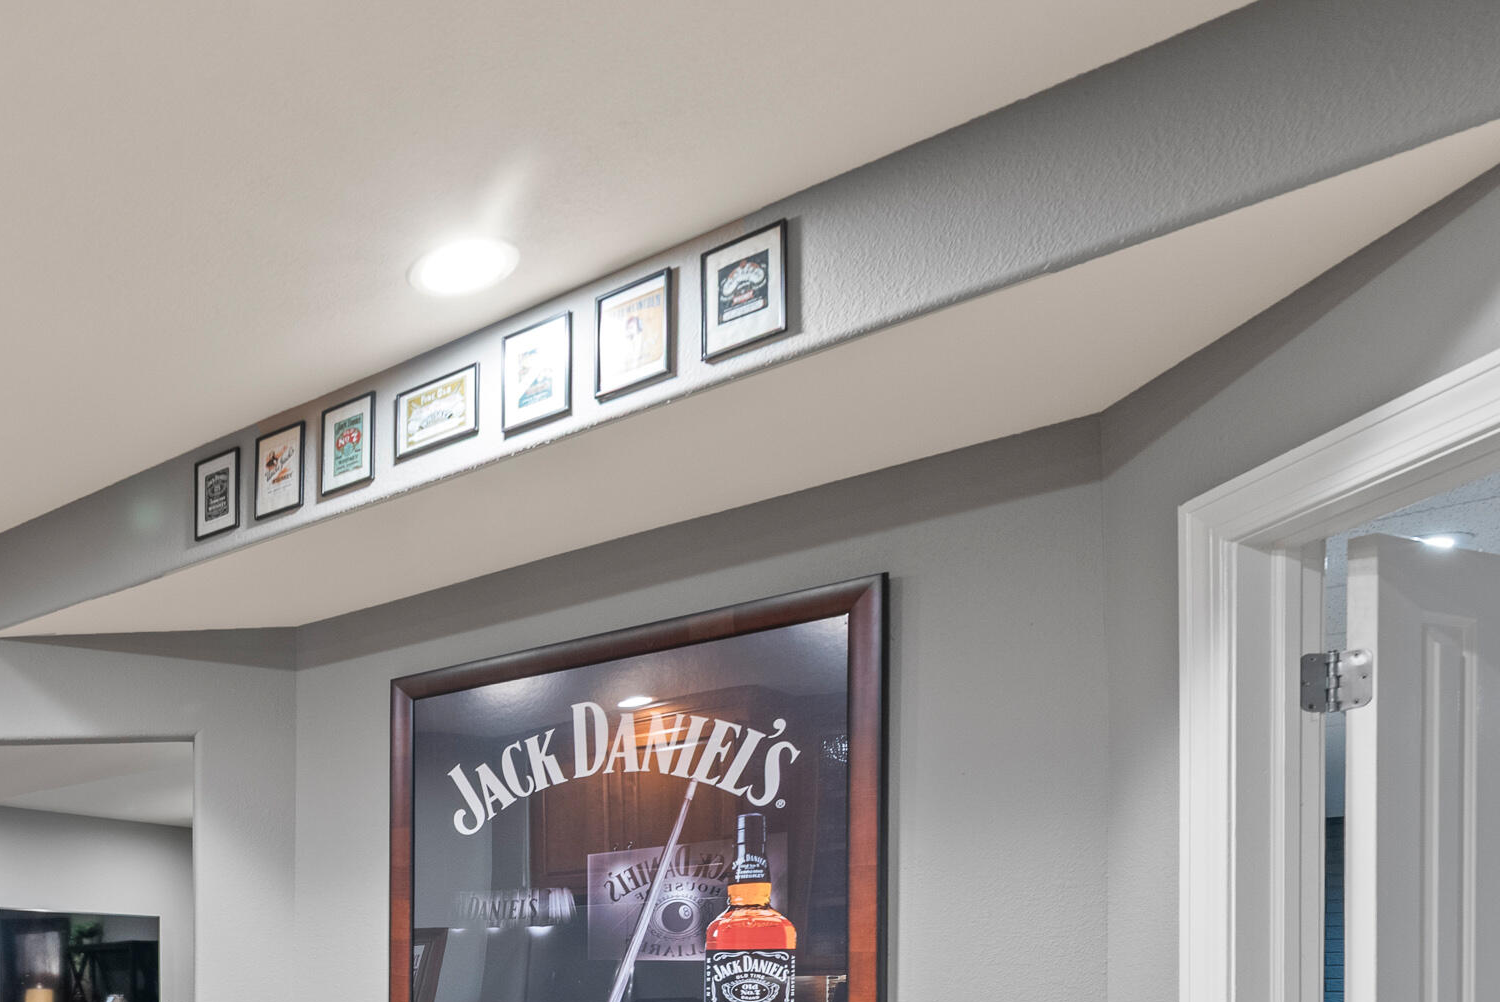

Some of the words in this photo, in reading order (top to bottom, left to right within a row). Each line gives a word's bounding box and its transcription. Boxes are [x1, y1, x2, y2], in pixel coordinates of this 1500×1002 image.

[447, 728, 569, 836] JACK
[570, 701, 801, 807] DANIEL'S
[713, 959, 743, 982] JACK
[742, 955, 790, 982] DANIEL'S
